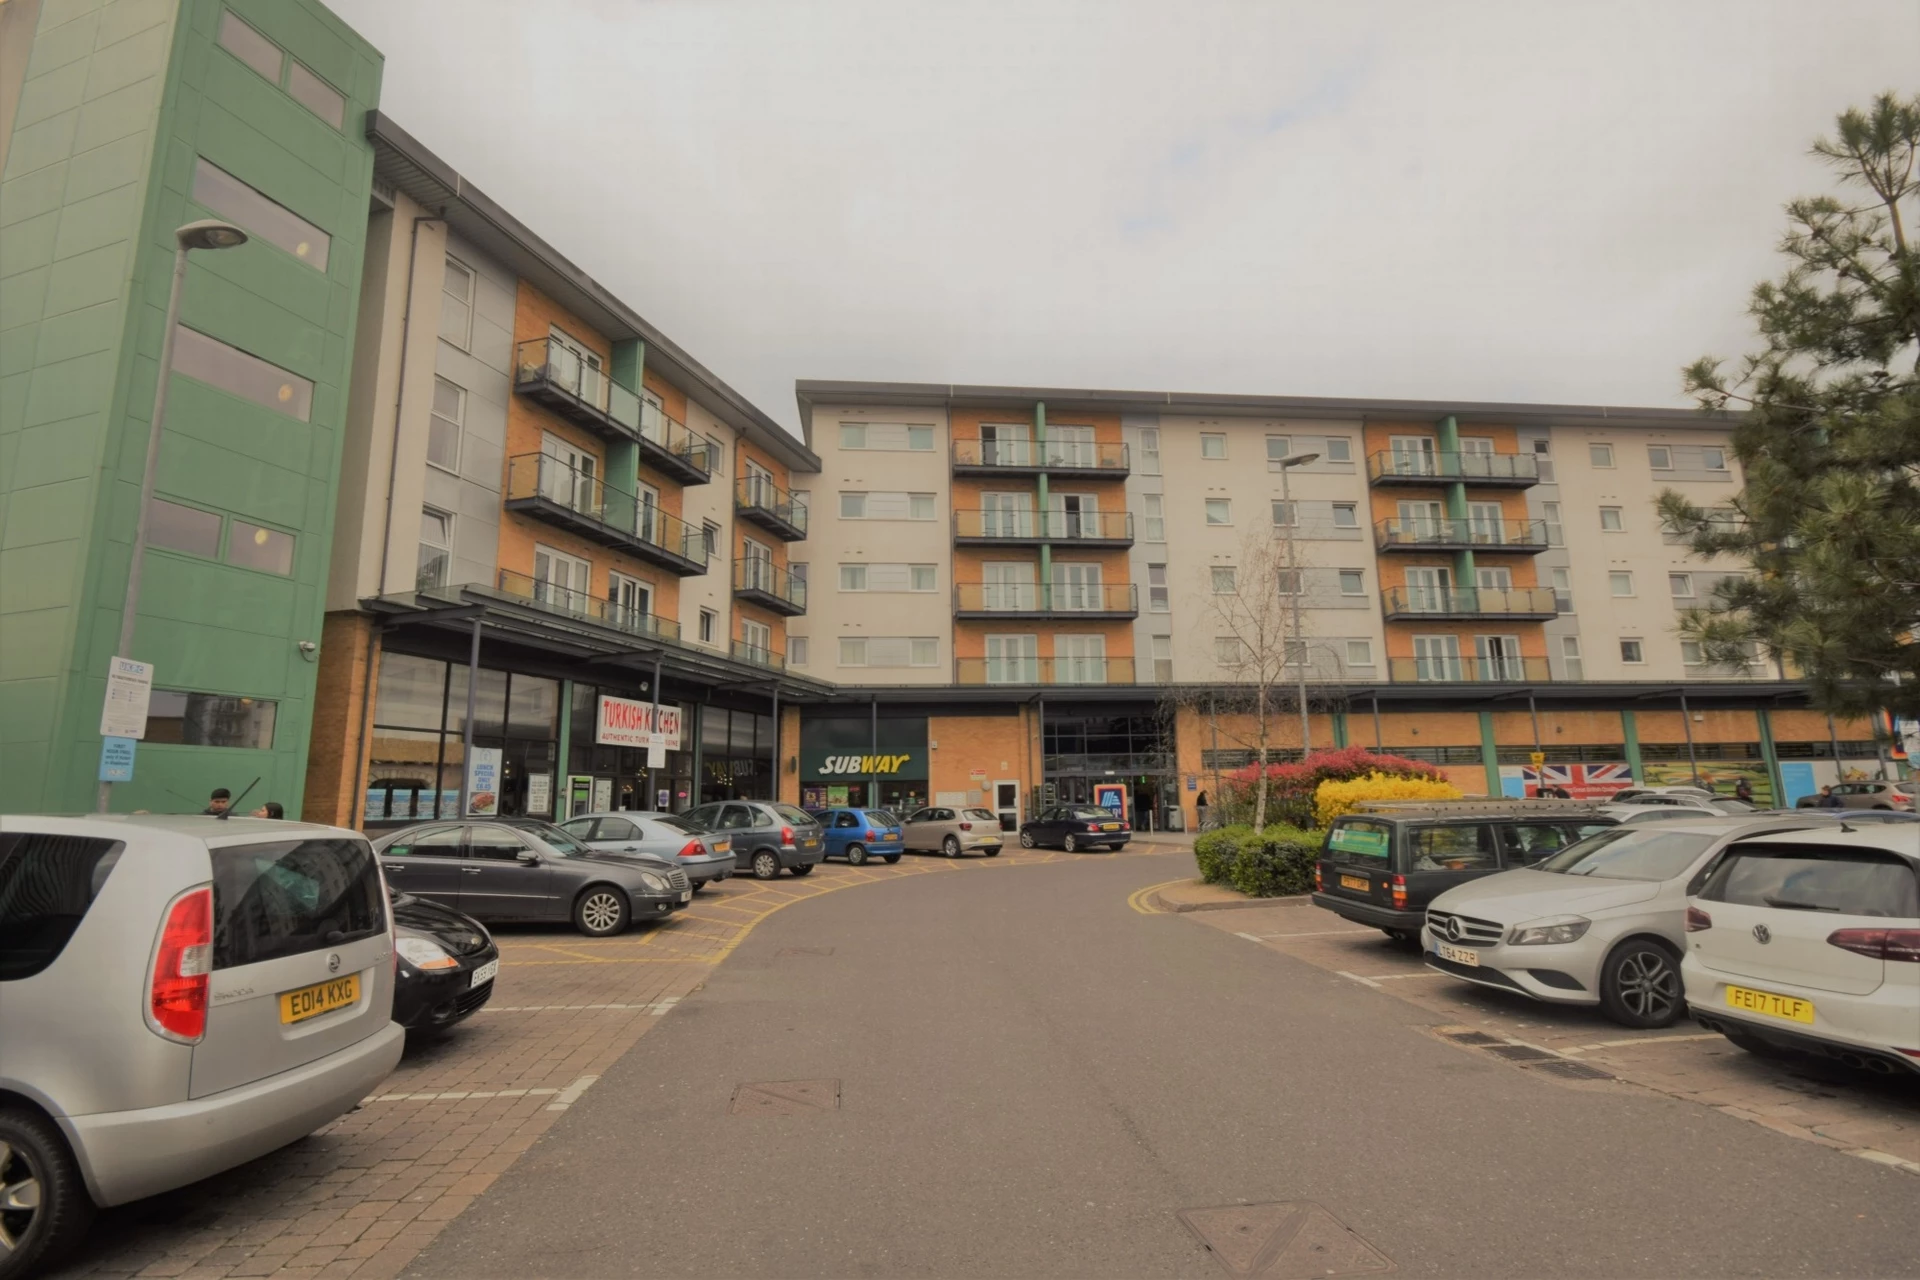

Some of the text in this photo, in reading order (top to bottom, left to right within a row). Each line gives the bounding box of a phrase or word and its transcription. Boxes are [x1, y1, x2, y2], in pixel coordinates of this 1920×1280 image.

[604, 700, 643, 730] TURKISH
[818, 754, 910, 774] SUBWAY
[1457, 950, 1476, 964] ZZR
[291, 980, 352, 1016] EO14 KXG
[1734, 989, 1803, 1017] FE17 TLF
